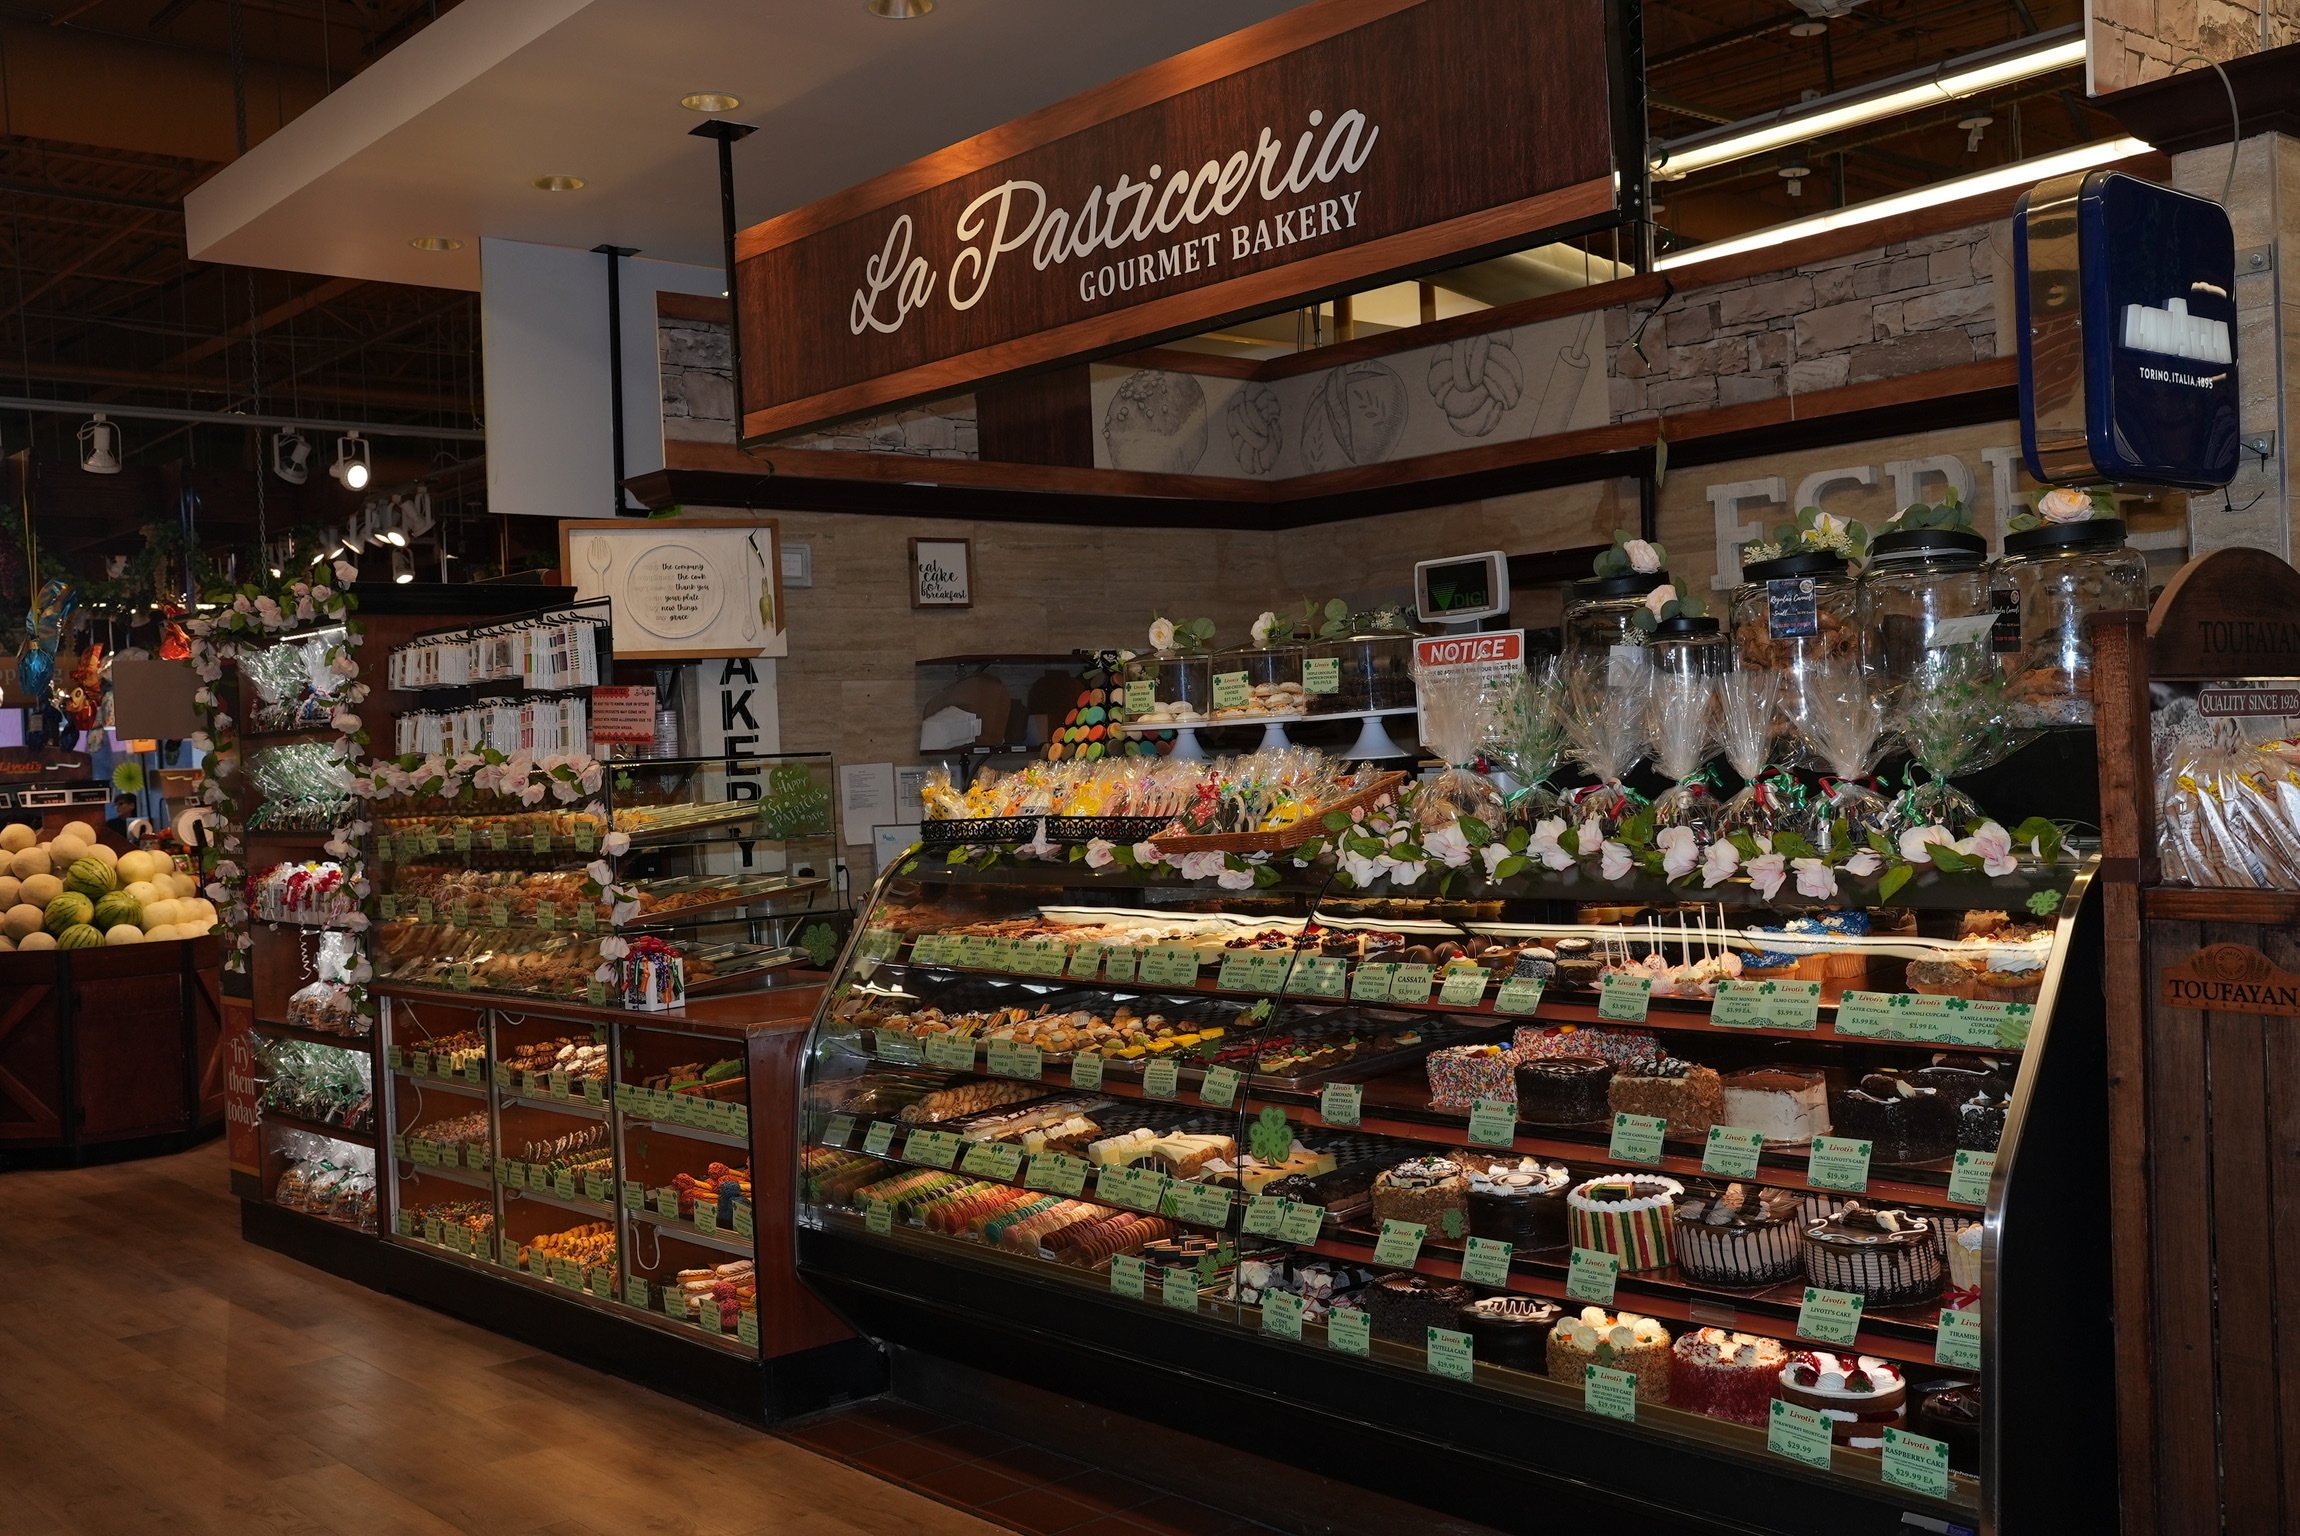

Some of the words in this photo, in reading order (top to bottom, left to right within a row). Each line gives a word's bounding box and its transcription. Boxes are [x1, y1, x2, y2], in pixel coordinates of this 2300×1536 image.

[850, 214, 936, 336] La
[948, 108, 1380, 311] Pasticceria
[1079, 235, 1222, 303] GOURMET
[1231, 191, 1363, 261] BAKERY
[919, 559, 940, 573] eat
[924, 568, 958, 582] cake
[921, 580, 943, 596] for
[926, 589, 967, 601] breakfast
[1454, 590, 1488, 608] DIGI
[1430, 639, 1507, 663] NOTICE
[2201, 693, 2247, 713] QUALITY
[2249, 694, 2278, 711] SINCE
[2280, 693, 2300, 710] 1926
[776, 777, 808, 794] HAPPY
[1397, 976, 1427, 984] CASSATA
[224, 1034, 250, 1072] Try
[228, 1065, 255, 1096] them
[1826, 1171, 1849, 1180] $19.99
[1581, 1285, 1601, 1294] $29.99
[1810, 1306, 1835, 1315] LIVOTI'S
[1815, 1324, 1840, 1334] $29.99
[1949, 1330, 1980, 1341] TIRAMISU
[1431, 1343, 1454, 1353] NUTELLA
[1954, 1349, 1978, 1360] $29.99
[1601, 1384, 1619, 1393] VELVET
[1773, 1419, 1802, 1432] STRAWBERRY
[1802, 1428, 1829, 1440] SHORTCAKE
[1787, 1440, 1812, 1454] $29.99
[1902, 1437, 1930, 1451] Livoti's
[1885, 1446, 1925, 1463] RASPBERRY
[1926, 1459, 1946, 1469] CAKE
[1895, 1467, 1922, 1480] $29.99
[1923, 1475, 1934, 1485] EA
